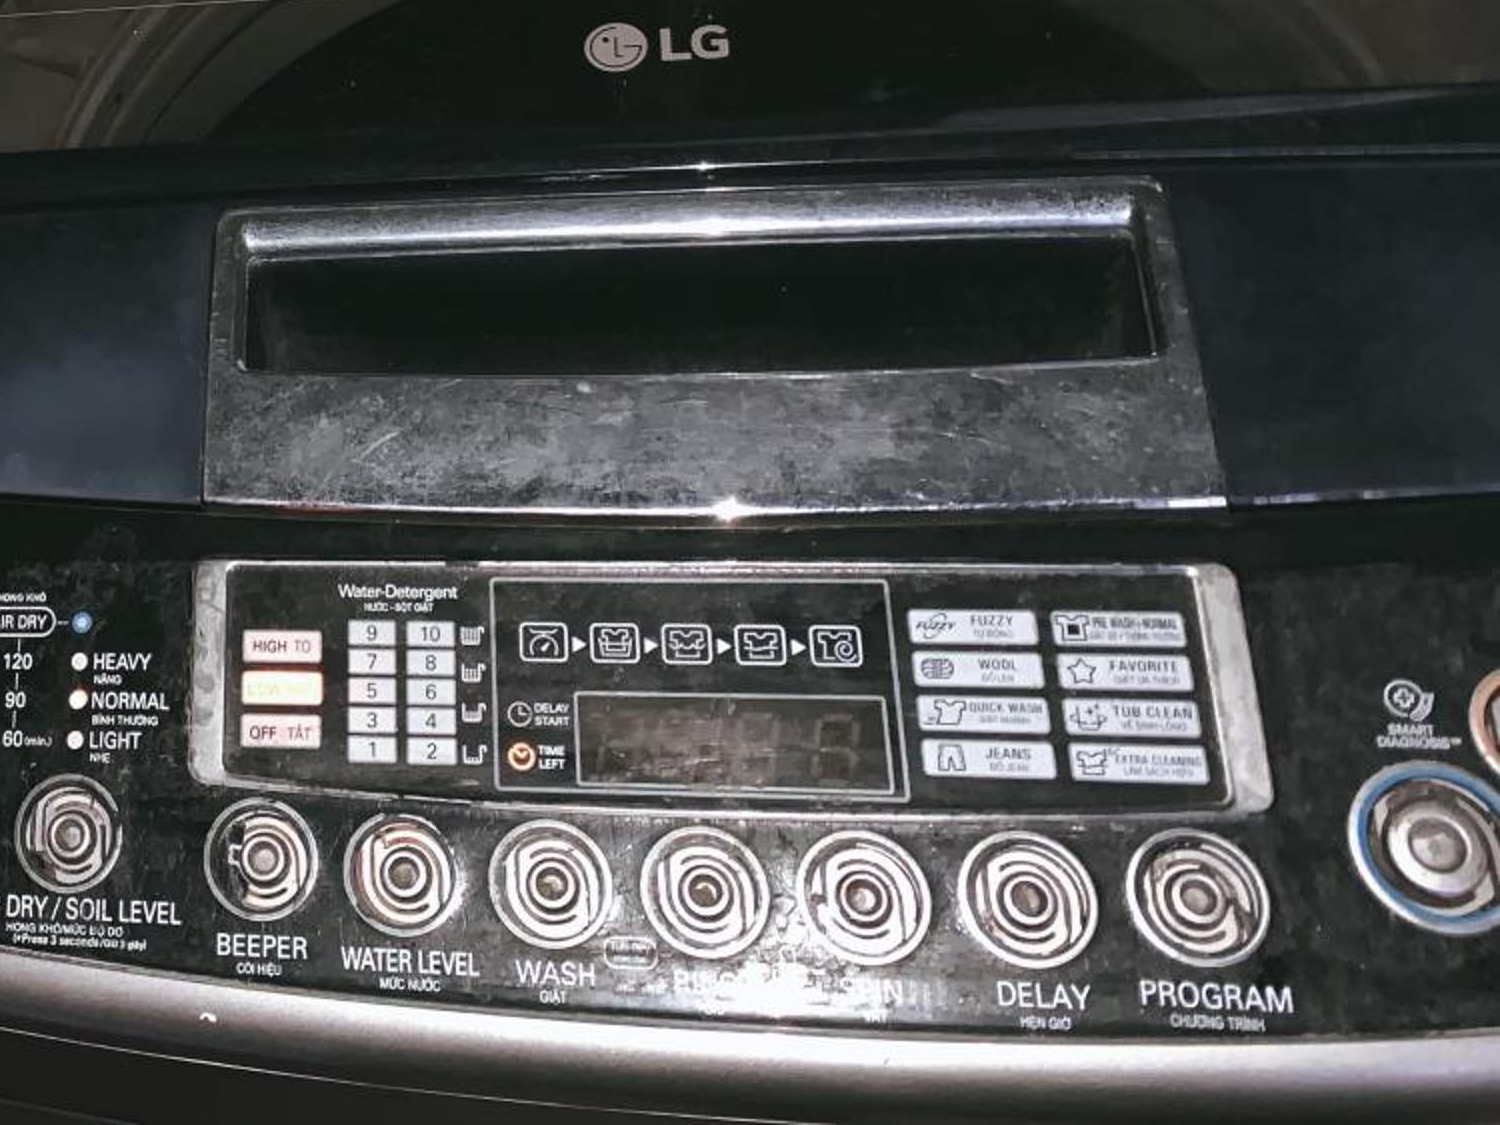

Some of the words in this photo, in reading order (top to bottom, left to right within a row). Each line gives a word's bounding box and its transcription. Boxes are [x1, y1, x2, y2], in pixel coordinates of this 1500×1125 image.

[659, 24, 730, 61] LG
[337, 582, 458, 602] Water-Detergent
[17, 615, 48, 630] DRY
[969, 614, 1014, 626] FUZZY
[367, 627, 377, 641] 9
[421, 627, 441, 642] 10
[252, 640, 288, 653] HIGH
[4, 653, 33, 670] 120
[93, 652, 152, 671] HEAVY
[367, 655, 377, 670] 7
[425, 655, 437, 671] 8
[977, 658, 1017, 671] WOOL
[1109, 659, 1179, 673] FAVORITE
[367, 683, 377, 699] 5
[425, 684, 437, 700] 6
[5, 691, 26, 709] 90
[91, 691, 171, 711] NORMAL
[533, 702, 570, 714] DELAY
[969, 702, 1003, 714] QUICK
[1007, 703, 1043, 714] WASH
[367, 712, 377, 728] 3
[425, 712, 438, 729] 4
[534, 716, 570, 726] START
[1145, 706, 1194, 720] CLEAN
[249, 725, 277, 740] OFF
[1387, 723, 1433, 736] SMART
[89, 730, 143, 750] LIGHT
[369, 741, 376, 757] 1
[426, 742, 438, 760] 2
[986, 747, 1032, 761] JEANS
[538, 758, 566, 770] LEFT
[1114, 754, 1148, 766] EXTRA
[6, 894, 48, 919] DRY
[65, 896, 113, 922] SOIL
[118, 900, 182, 926] LEVEL
[216, 932, 308, 960] BEEPER
[341, 945, 413, 973] WATER
[417, 951, 480, 978] LEVEL
[516, 960, 596, 988] WASH
[996, 980, 1091, 1011] DELAY
[1139, 979, 1295, 1014] PROGRAM
